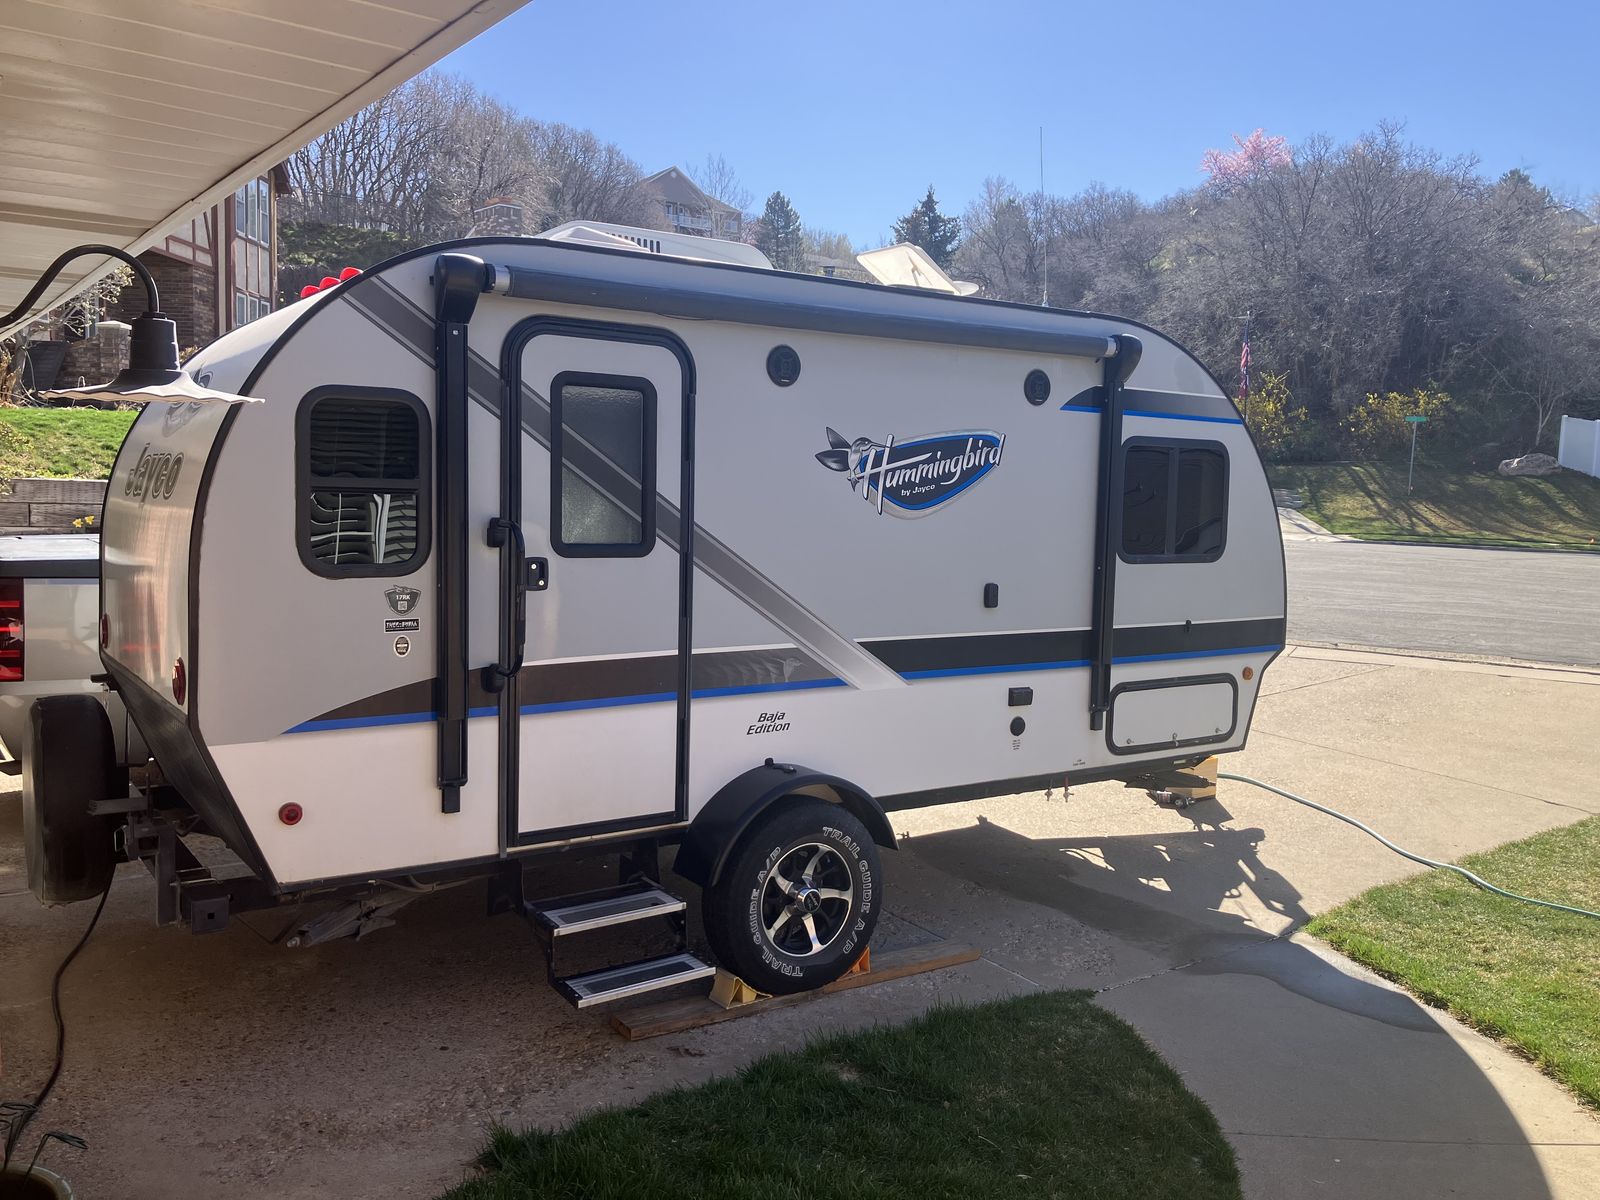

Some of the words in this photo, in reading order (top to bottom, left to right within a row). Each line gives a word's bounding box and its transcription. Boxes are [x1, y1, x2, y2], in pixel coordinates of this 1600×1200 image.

[125, 443, 184, 503] Jayco
[855, 433, 1007, 515] Hummingbird
[901, 488, 911, 497] by
[912, 484, 936, 495] Jayco
[746, 723, 791, 735] Edition
[757, 711, 786, 723] Baja
[822, 826, 861, 859] TRAIL
[858, 859, 873, 914] GUIDE
[749, 888, 761, 945] GUIDE
[762, 945, 804, 977] TRAIL
